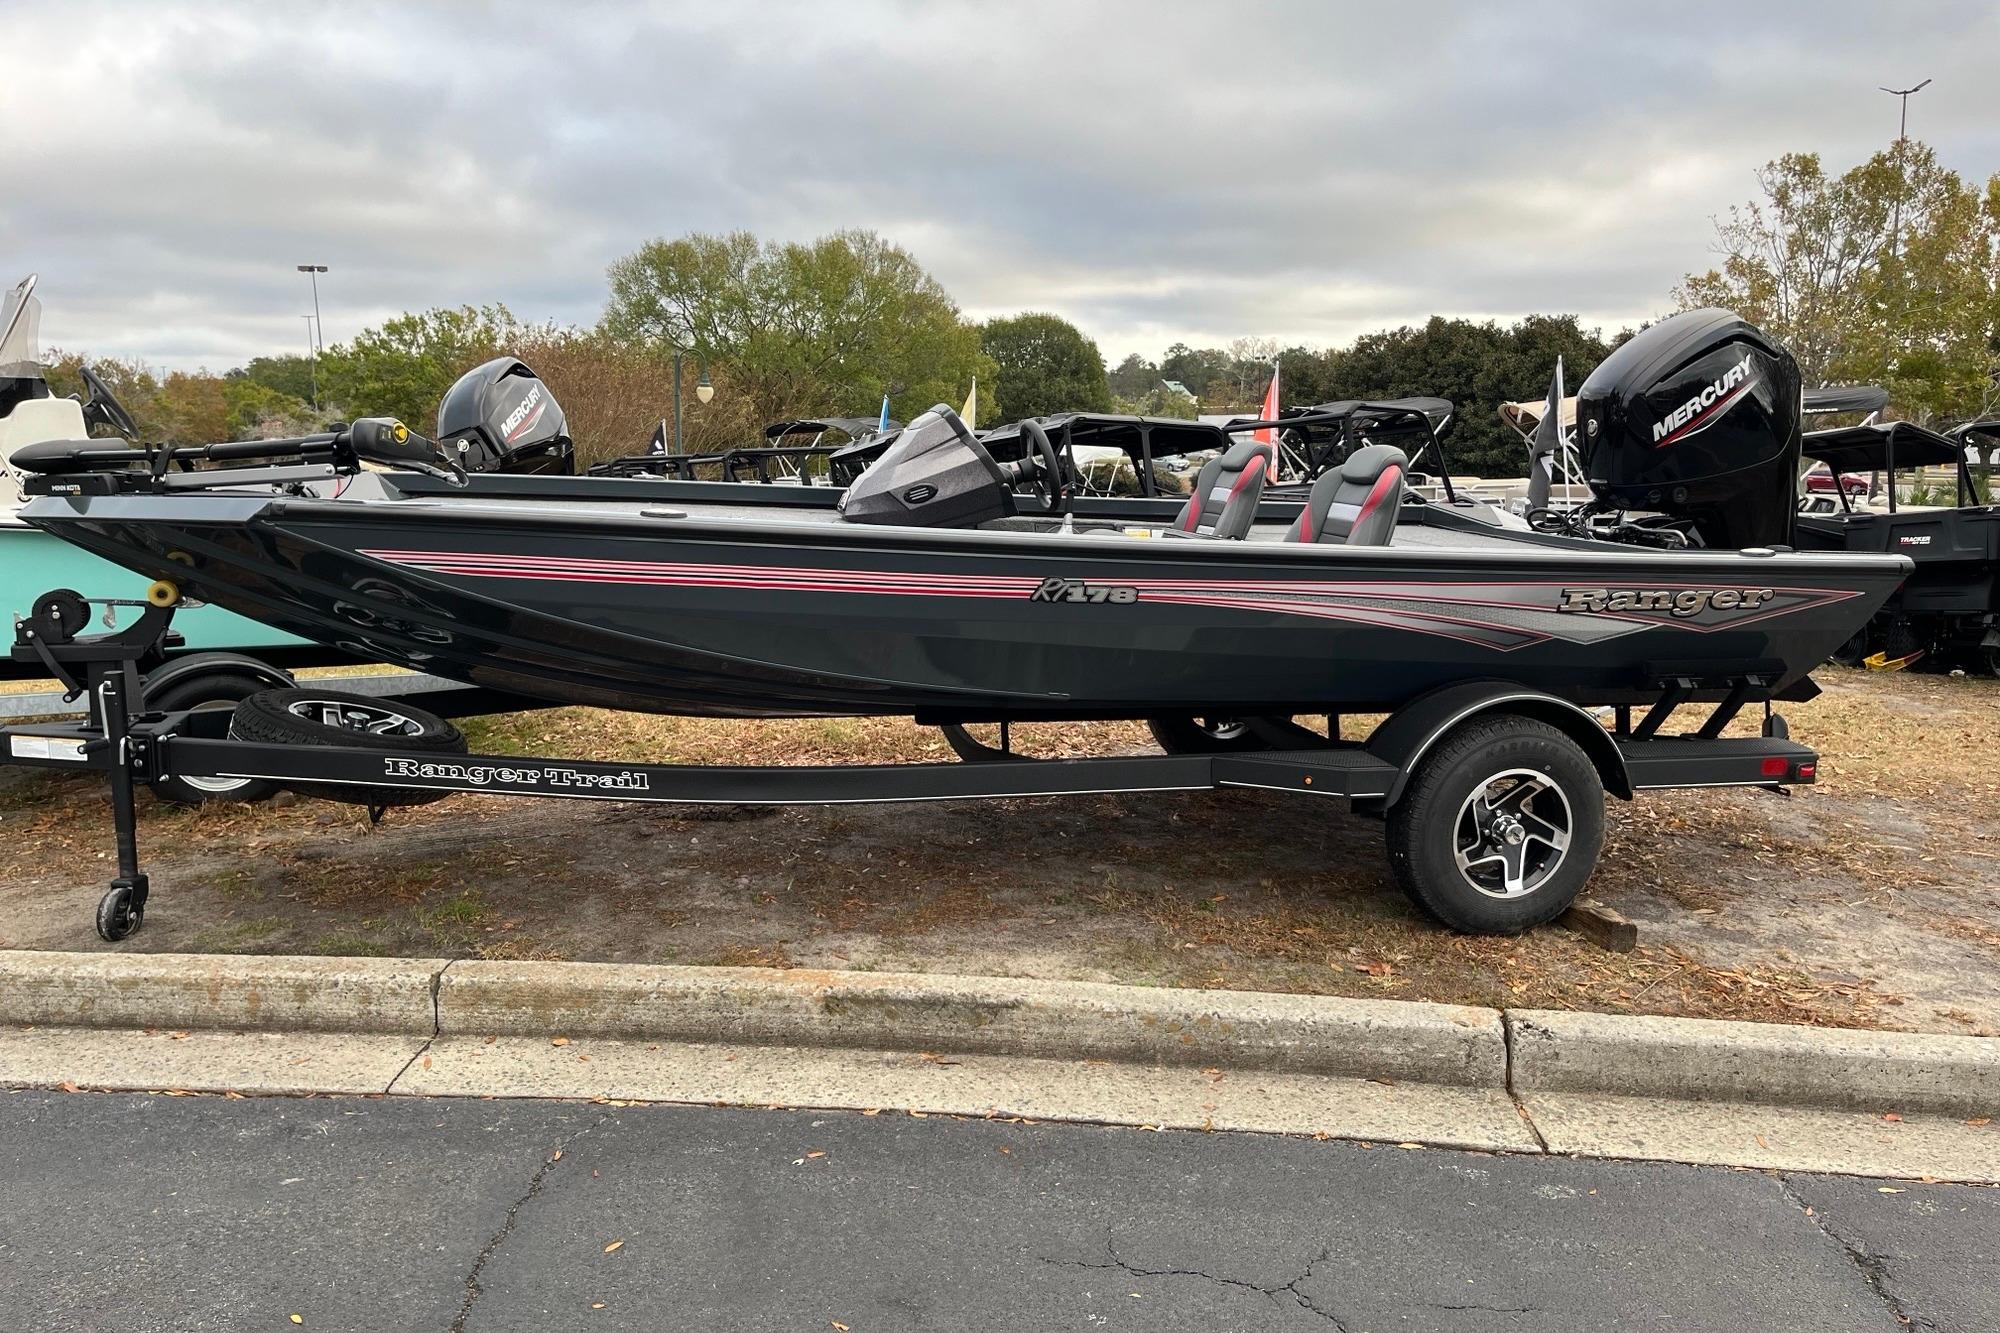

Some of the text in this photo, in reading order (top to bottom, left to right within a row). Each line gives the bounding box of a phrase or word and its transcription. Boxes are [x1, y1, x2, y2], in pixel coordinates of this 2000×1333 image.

[500, 383, 541, 438] MERCURY
[1652, 353, 1751, 442] MERCURY
[1557, 588, 1776, 617] Ranger
[384, 758, 650, 790] Ranger Trail
